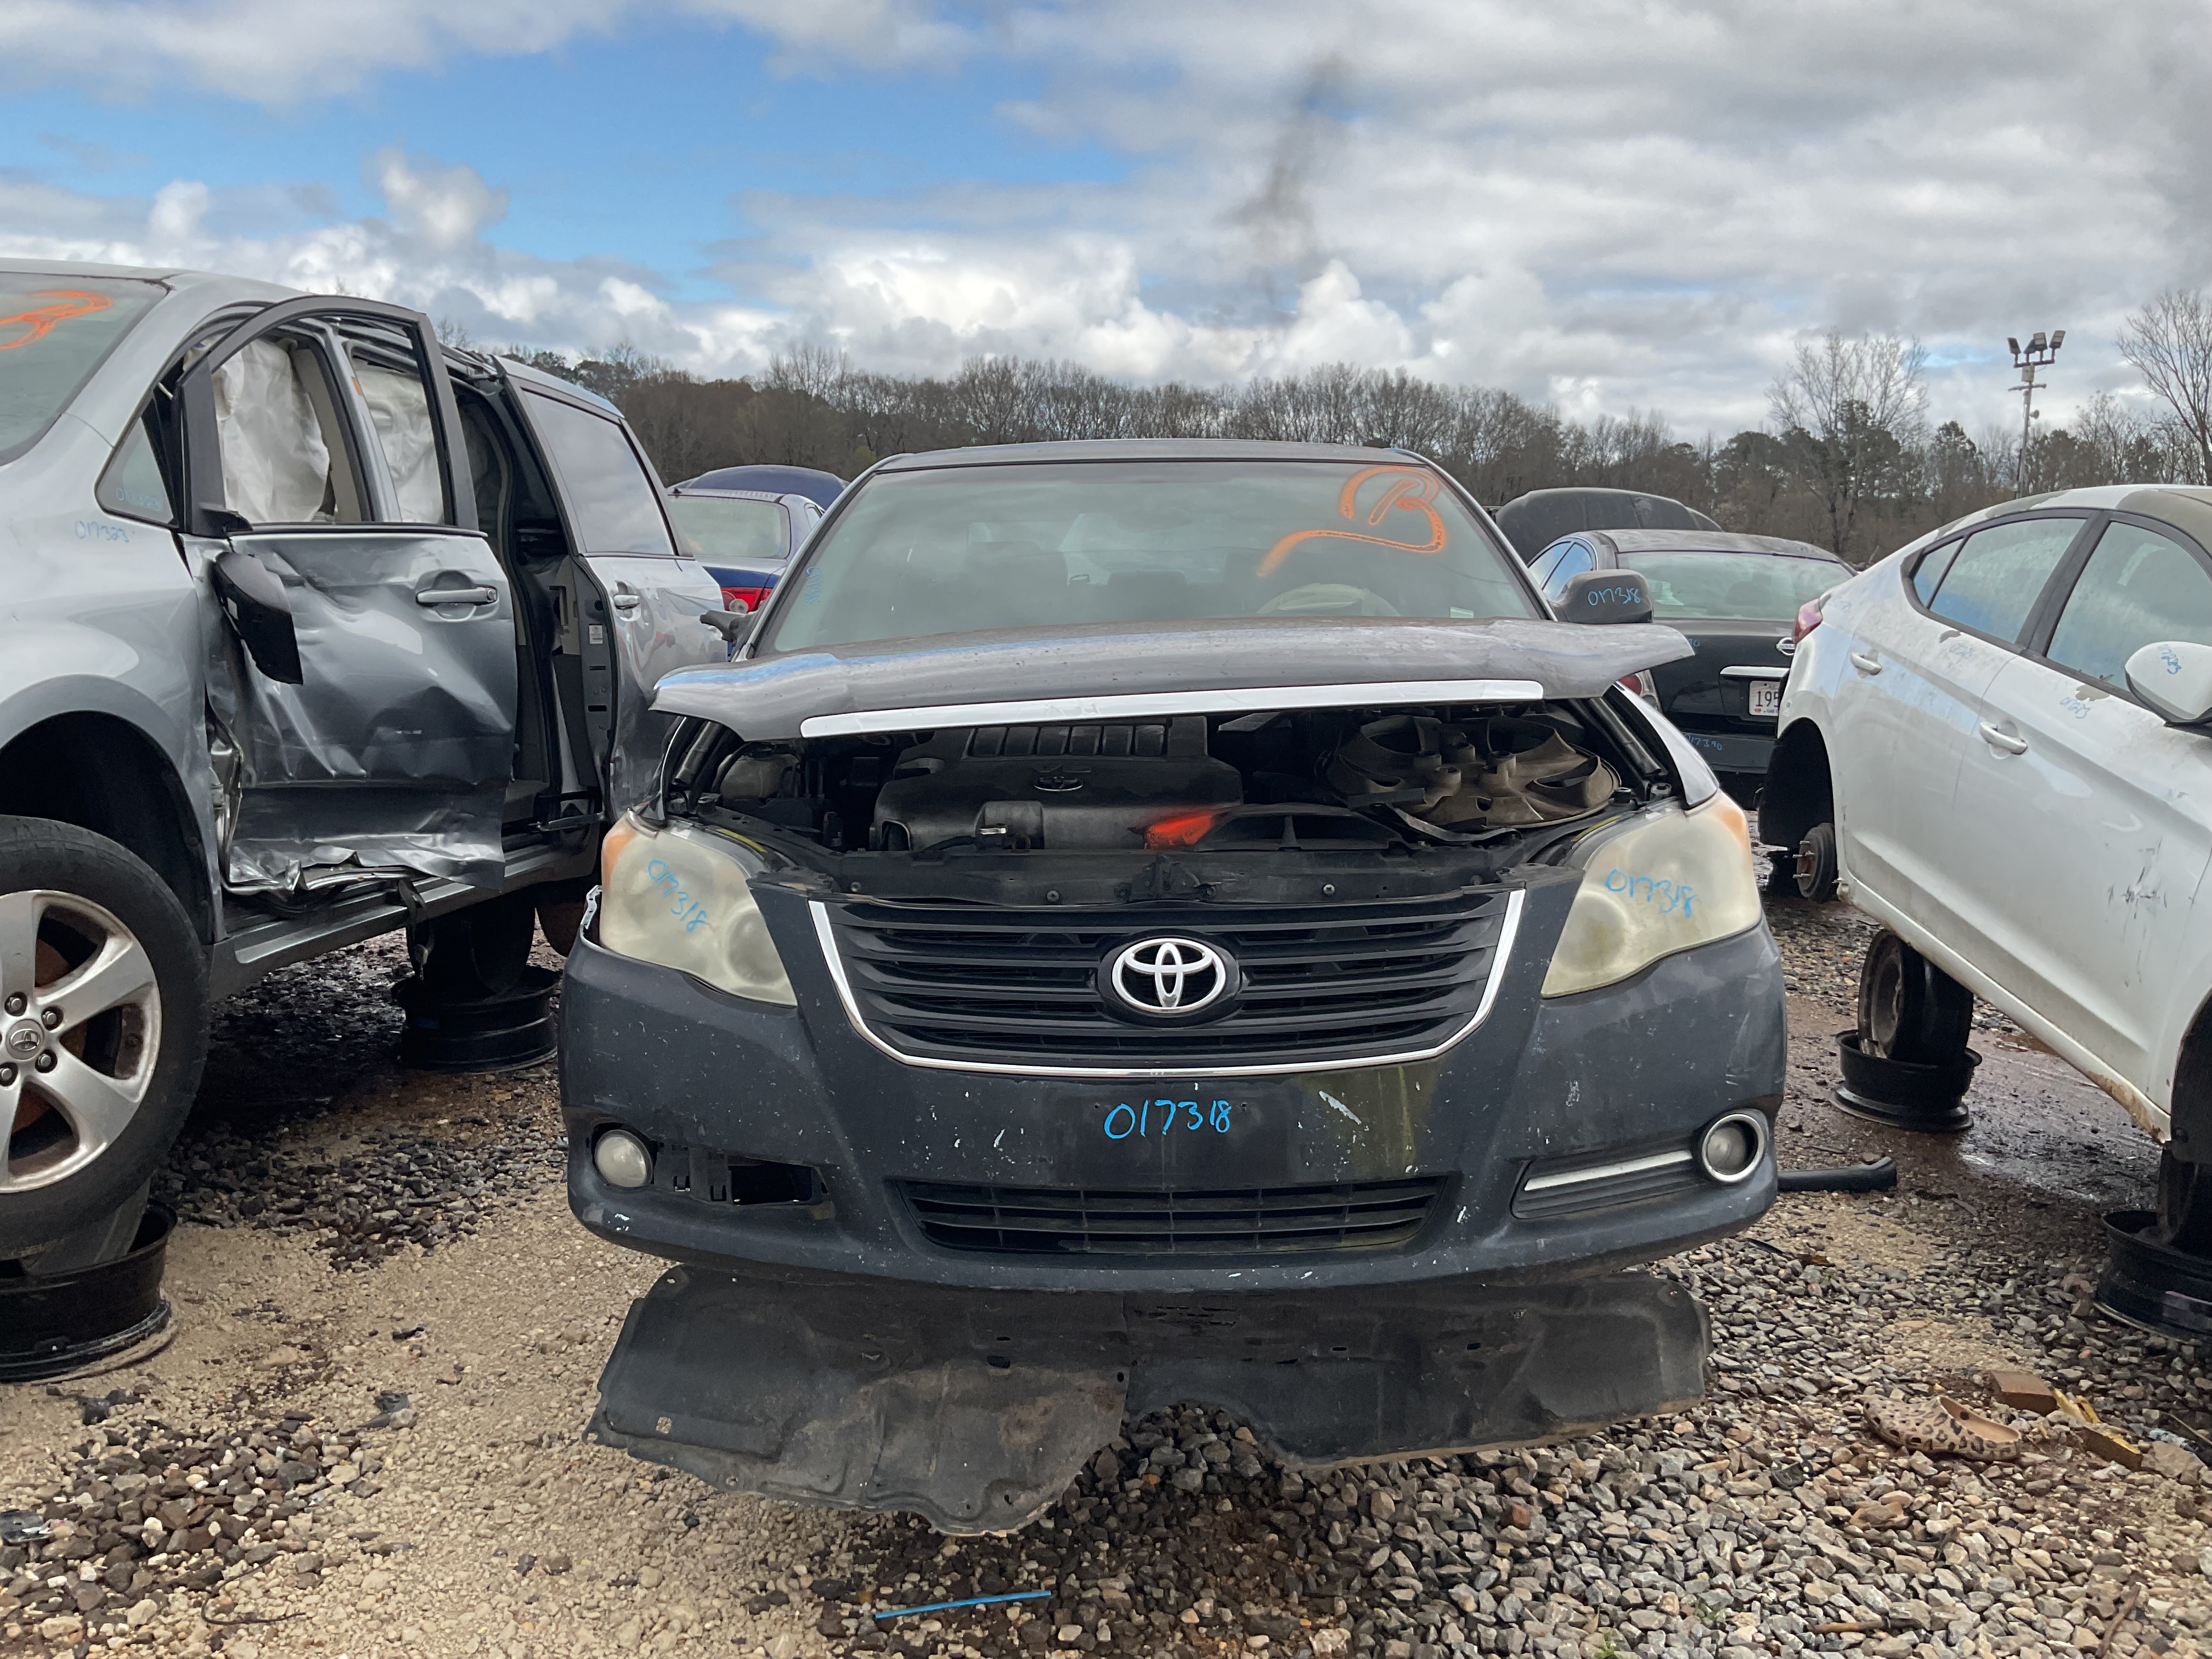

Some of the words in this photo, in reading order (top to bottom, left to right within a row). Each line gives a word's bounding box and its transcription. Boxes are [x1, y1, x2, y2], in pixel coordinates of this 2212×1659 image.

[1588, 586, 1640, 606] 017318
[648, 860, 711, 933] 017318
[1605, 868, 1699, 919] 017318
[1104, 1099, 1232, 1139] 017318
